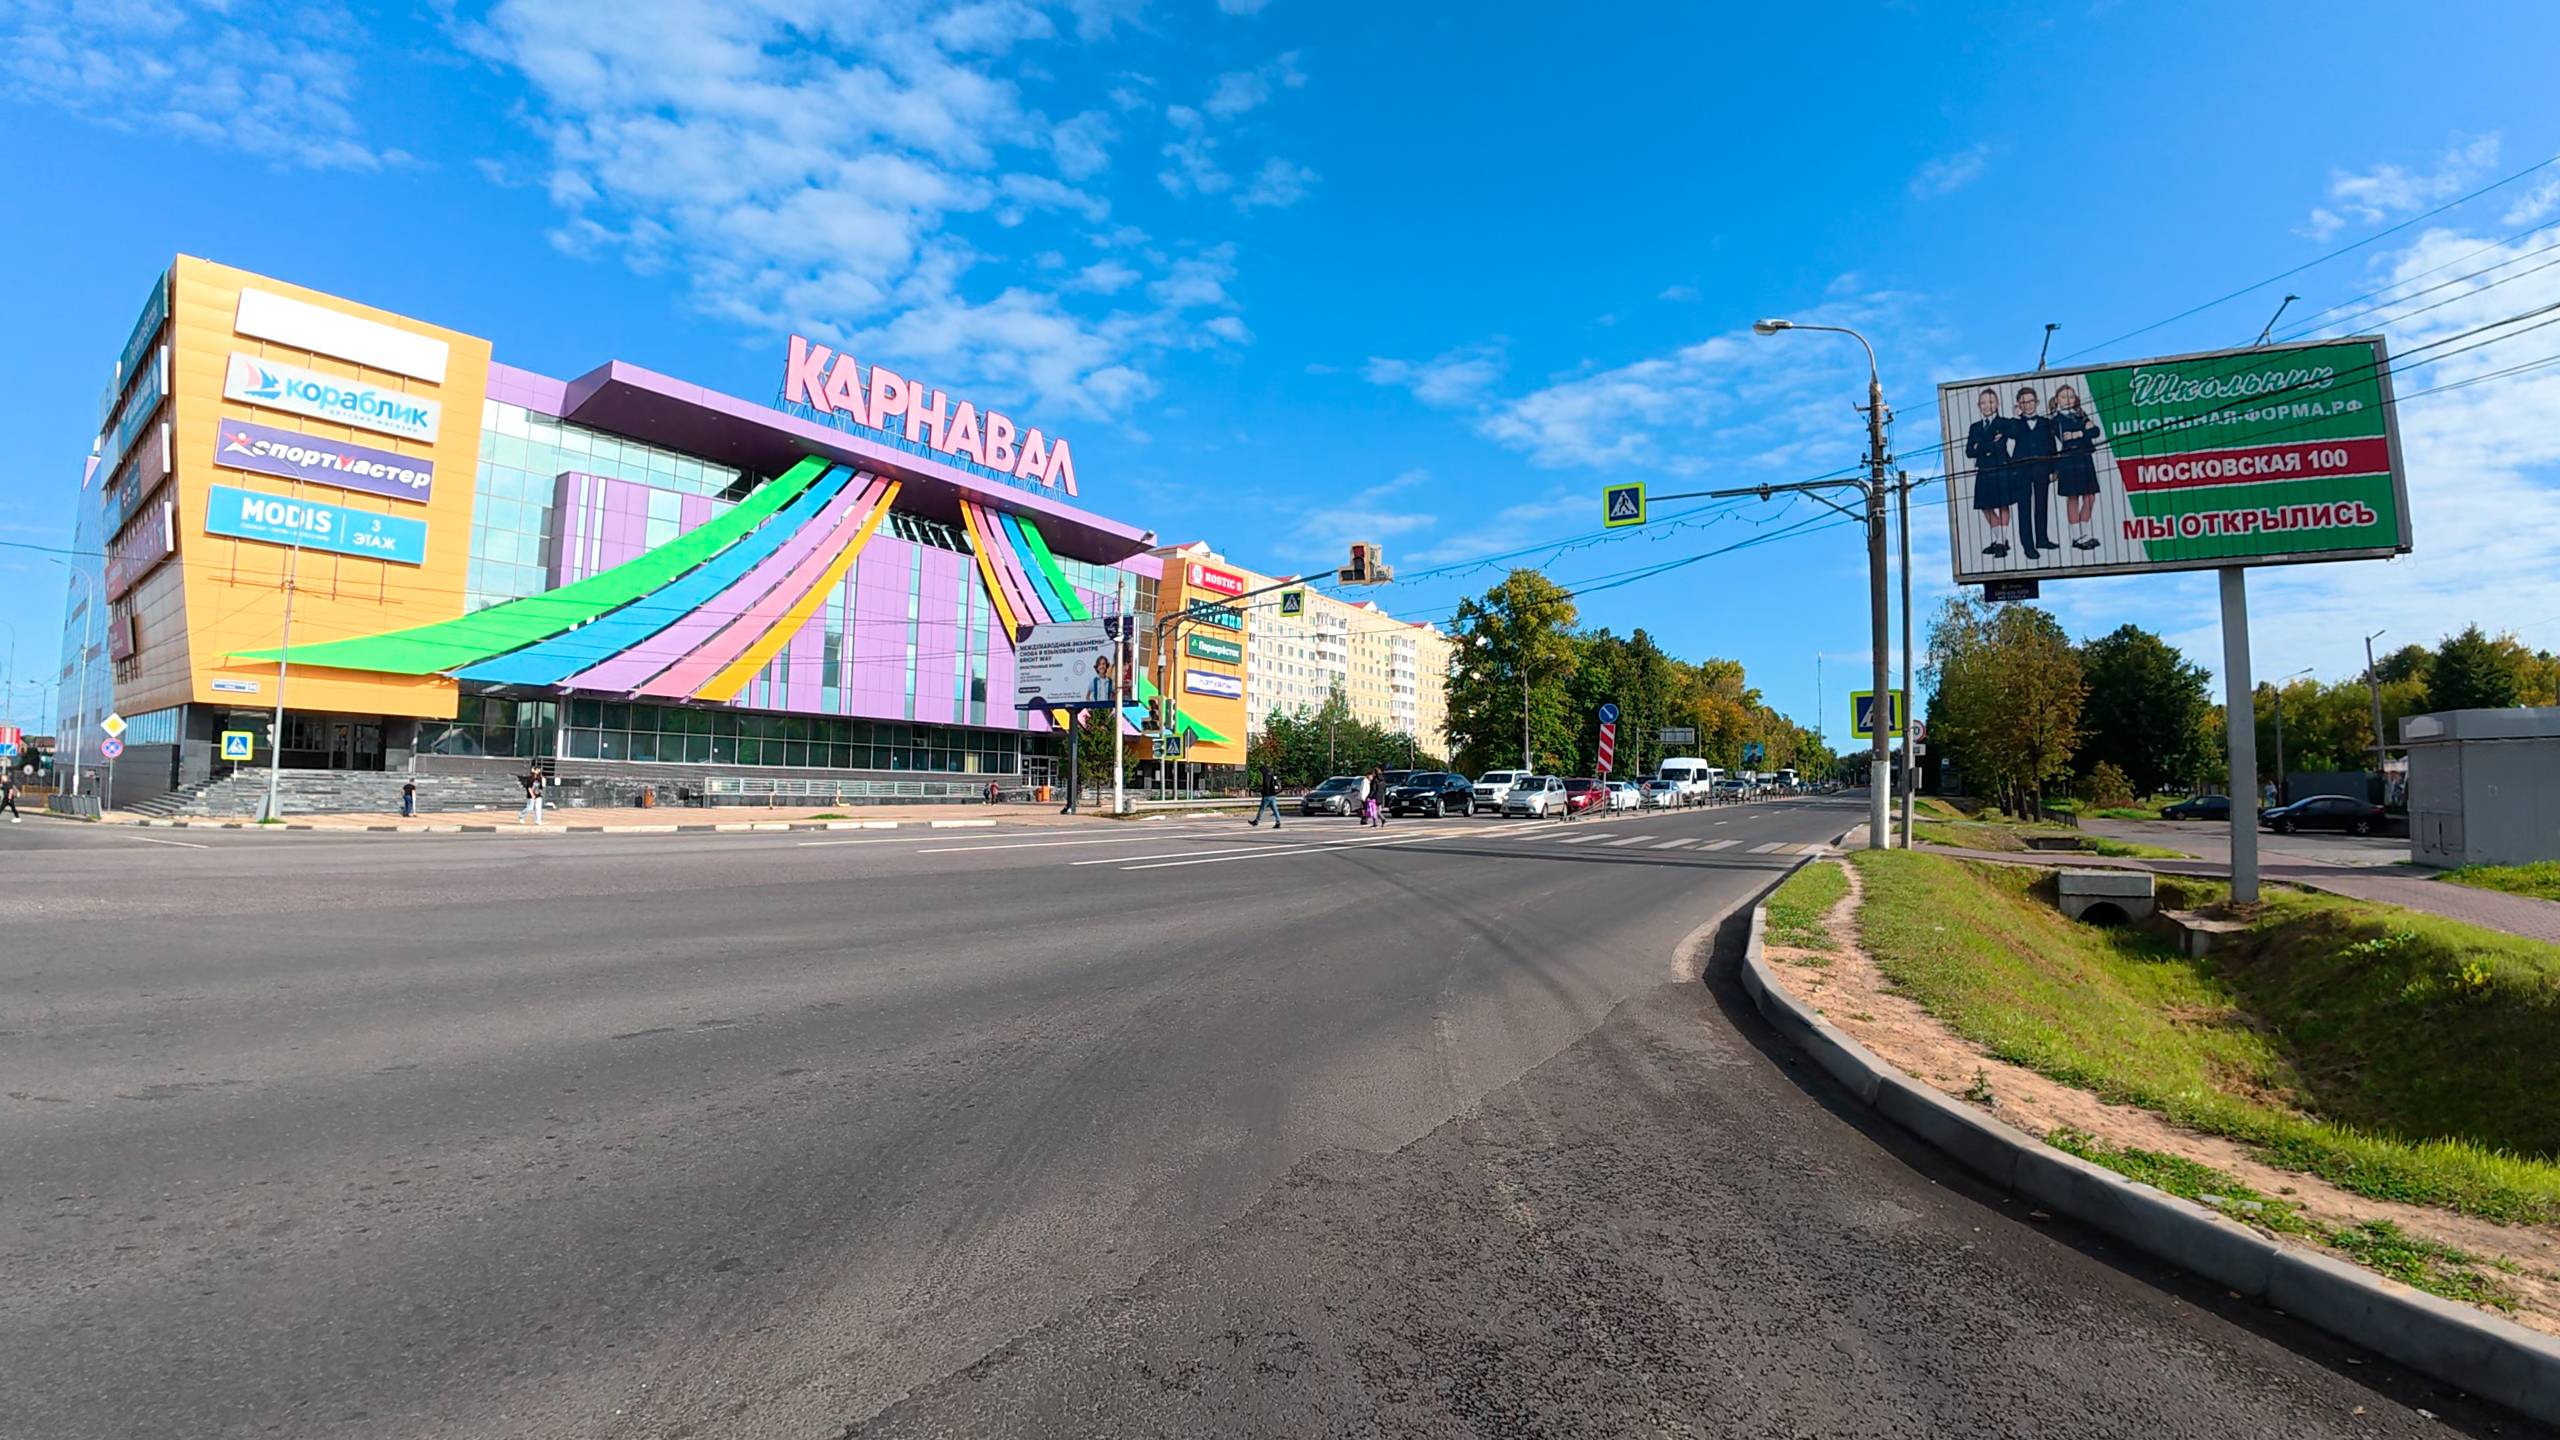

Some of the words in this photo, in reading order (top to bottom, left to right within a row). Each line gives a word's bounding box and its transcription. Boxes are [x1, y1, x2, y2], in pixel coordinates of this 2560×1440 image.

[2130, 366, 2334, 406] Школьник
[785, 334, 1078, 497] КАРНАВАЛ
[2112, 399, 2363, 436] ШКОЛЬНАЯ-ФОРМА.РФ
[252, 440, 431, 489] спортмастер
[2137, 452, 2302, 484] МОСКОВСКАЯ
[2306, 448, 2349, 471] 100
[241, 496, 332, 533] MODIS
[371, 519, 382, 533] 3
[2122, 513, 2176, 541] МЫ
[2179, 501, 2377, 537] ОТКРЫЛИСЬ
[352, 532, 396, 550] ЭТАЖ
